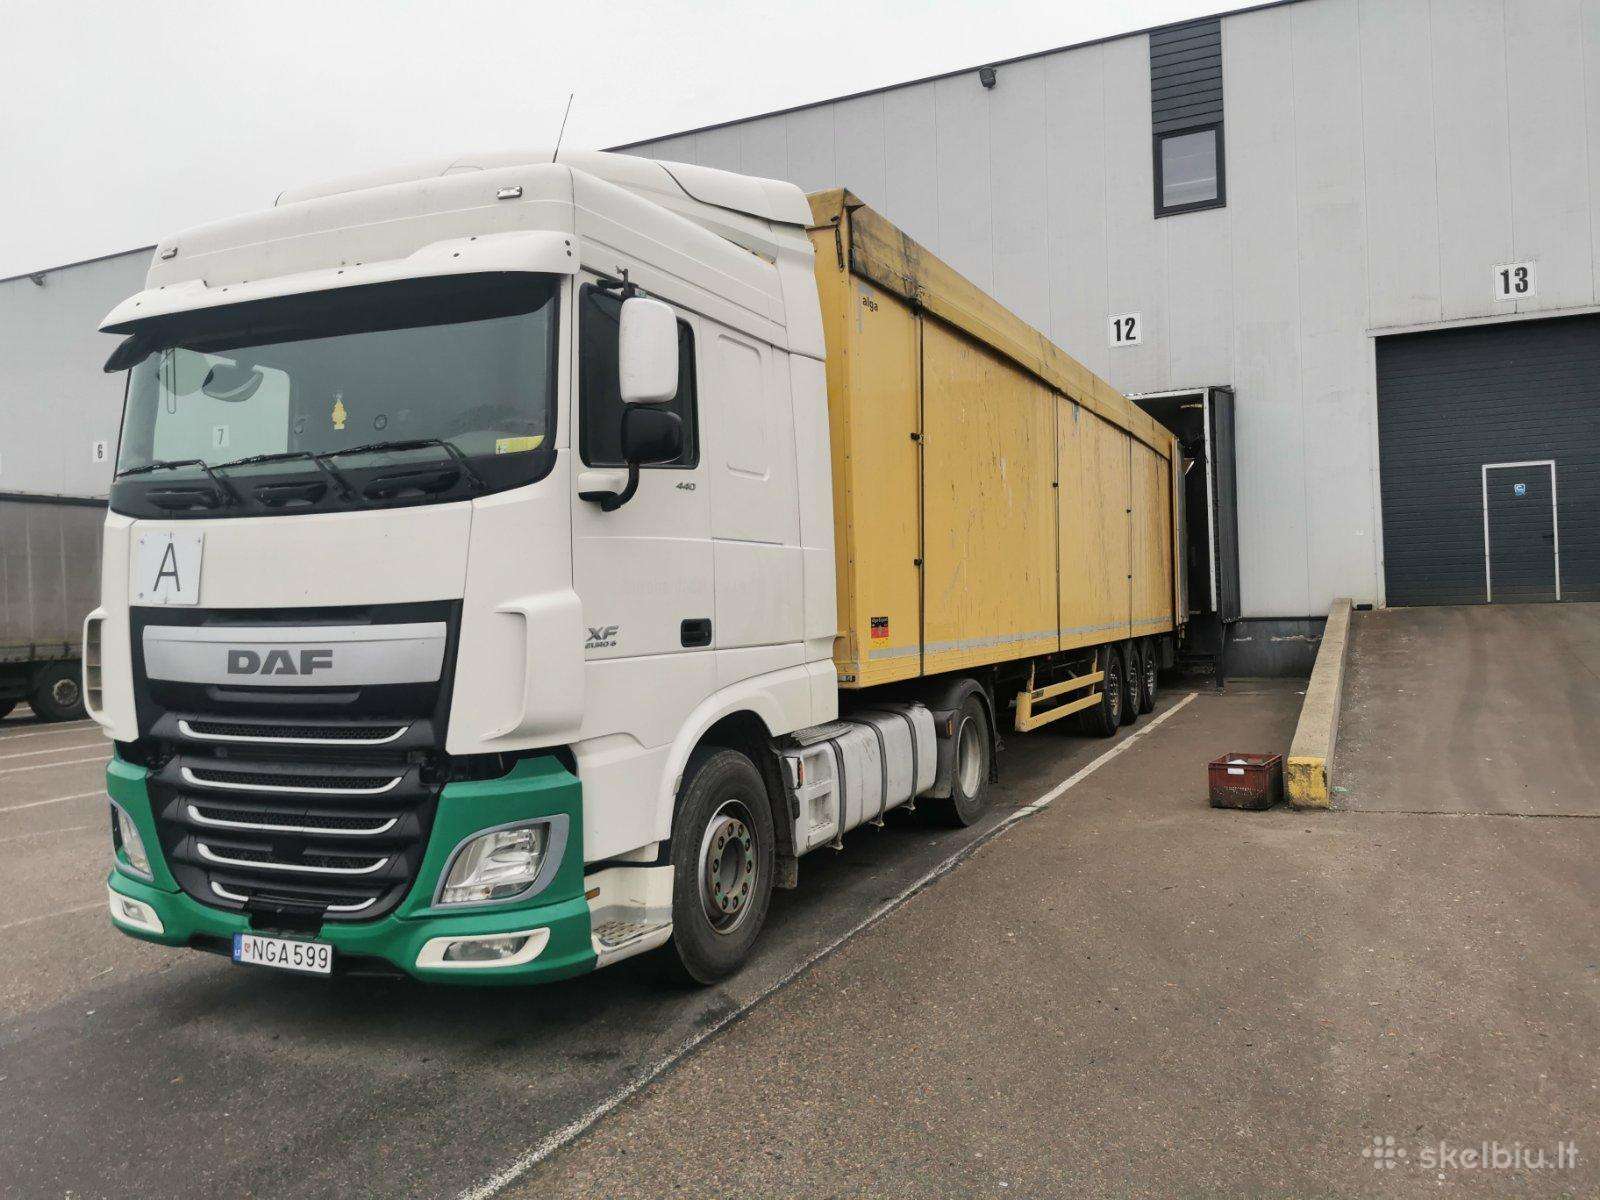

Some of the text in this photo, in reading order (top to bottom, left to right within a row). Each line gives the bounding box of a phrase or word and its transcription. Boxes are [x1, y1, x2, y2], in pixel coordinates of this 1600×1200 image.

[1500, 266, 1529, 295] 13
[1113, 317, 1137, 342] 12
[217, 428, 225, 445] 7
[97, 443, 103, 459] 6
[675, 481, 697, 491] 440
[153, 542, 181, 592] A
[585, 625, 619, 642] XF
[227, 649, 334, 676] DAF
